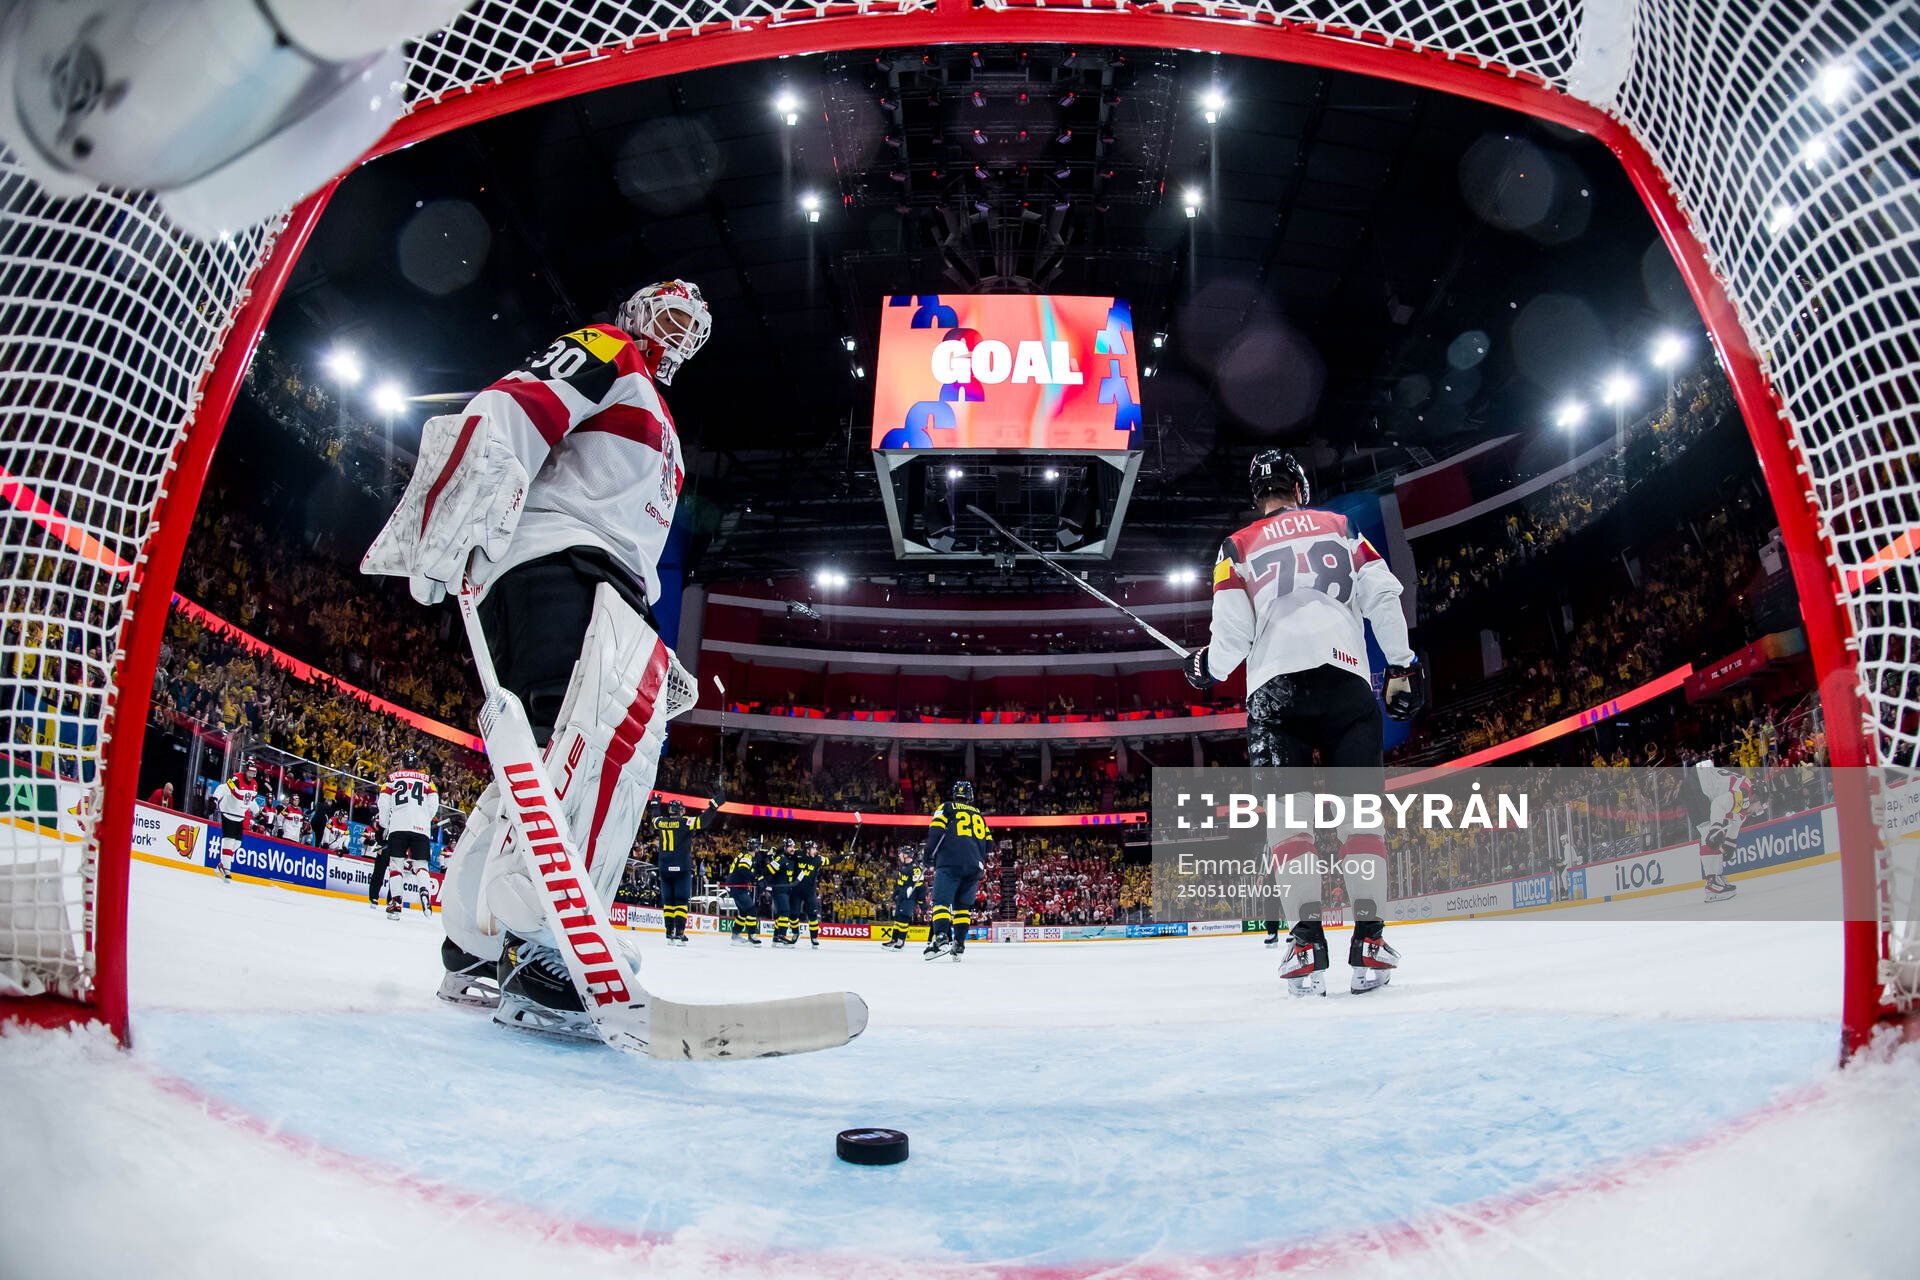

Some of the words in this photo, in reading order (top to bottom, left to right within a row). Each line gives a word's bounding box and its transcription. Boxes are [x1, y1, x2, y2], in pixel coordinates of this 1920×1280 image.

[531, 340, 587, 379] 30
[931, 340, 1083, 385] GOAL
[1260, 463, 1272, 476] 78
[1263, 514, 1320, 540] NICKL
[1250, 540, 1354, 604] 78
[394, 780, 424, 806] 24
[955, 811, 986, 840] 28
[661, 829, 674, 852] 11
[1724, 825, 1822, 868] ensWorlds
[208, 835, 325, 881] #ensWorlds
[503, 762, 631, 1008] WARRIOR
[1515, 877, 1547, 902] NOCCO
[1615, 859, 1664, 891] iLOQ
[1456, 893, 1498, 911] Stockholm
[822, 926, 869, 937] STRAUSS
